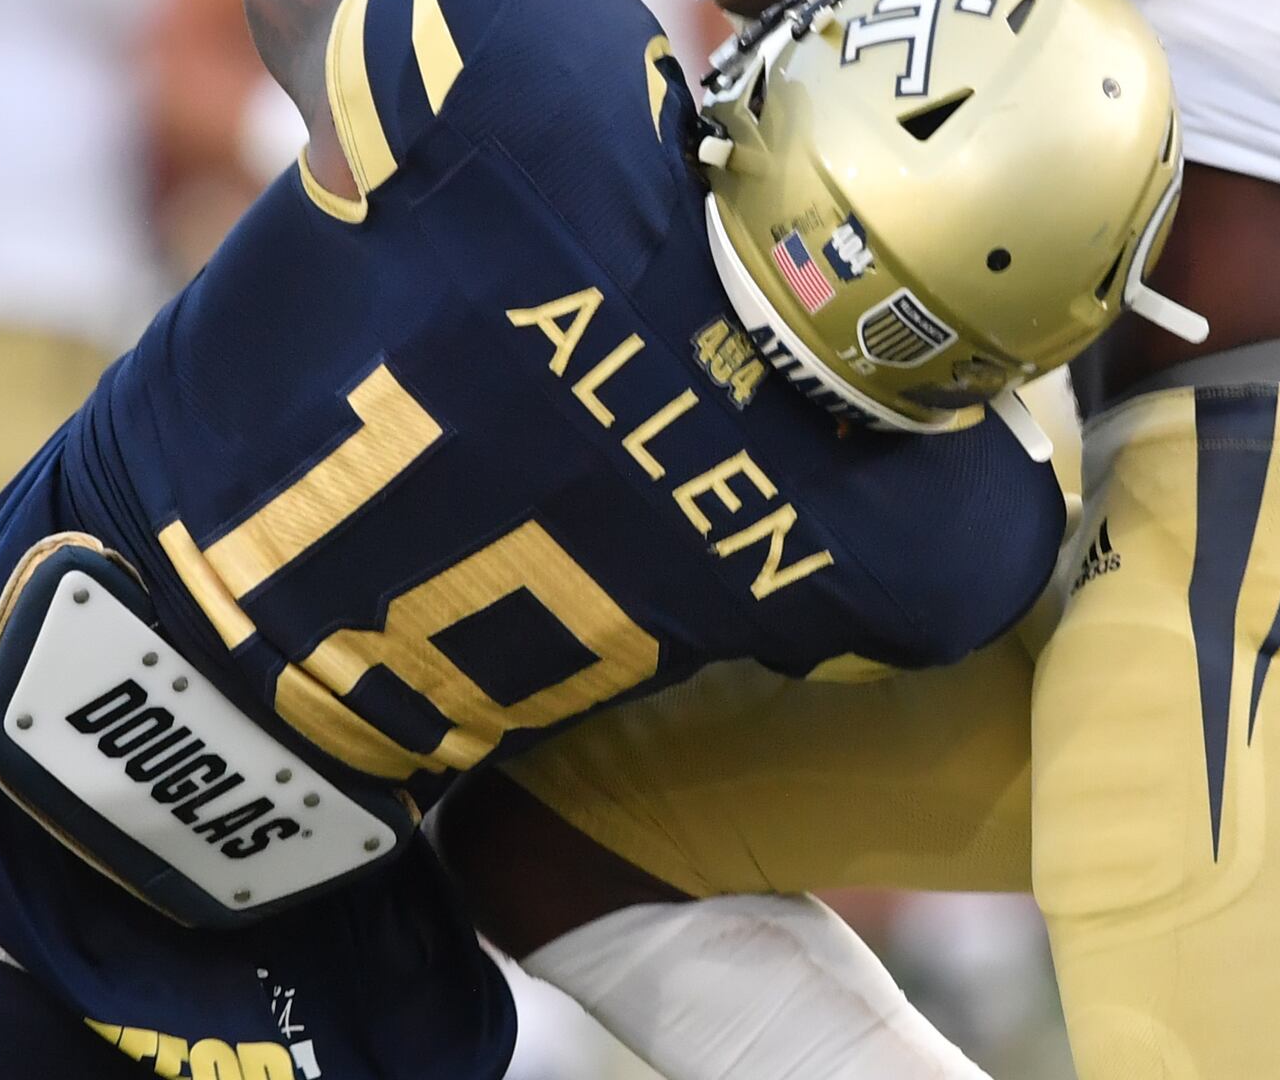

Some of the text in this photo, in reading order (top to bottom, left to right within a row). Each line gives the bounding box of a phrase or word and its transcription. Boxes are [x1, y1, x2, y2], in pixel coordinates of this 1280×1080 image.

[157, 360, 661, 781] 18
[505, 286, 833, 602] ALLEN
[65, 677, 300, 860] DOUGLAS
